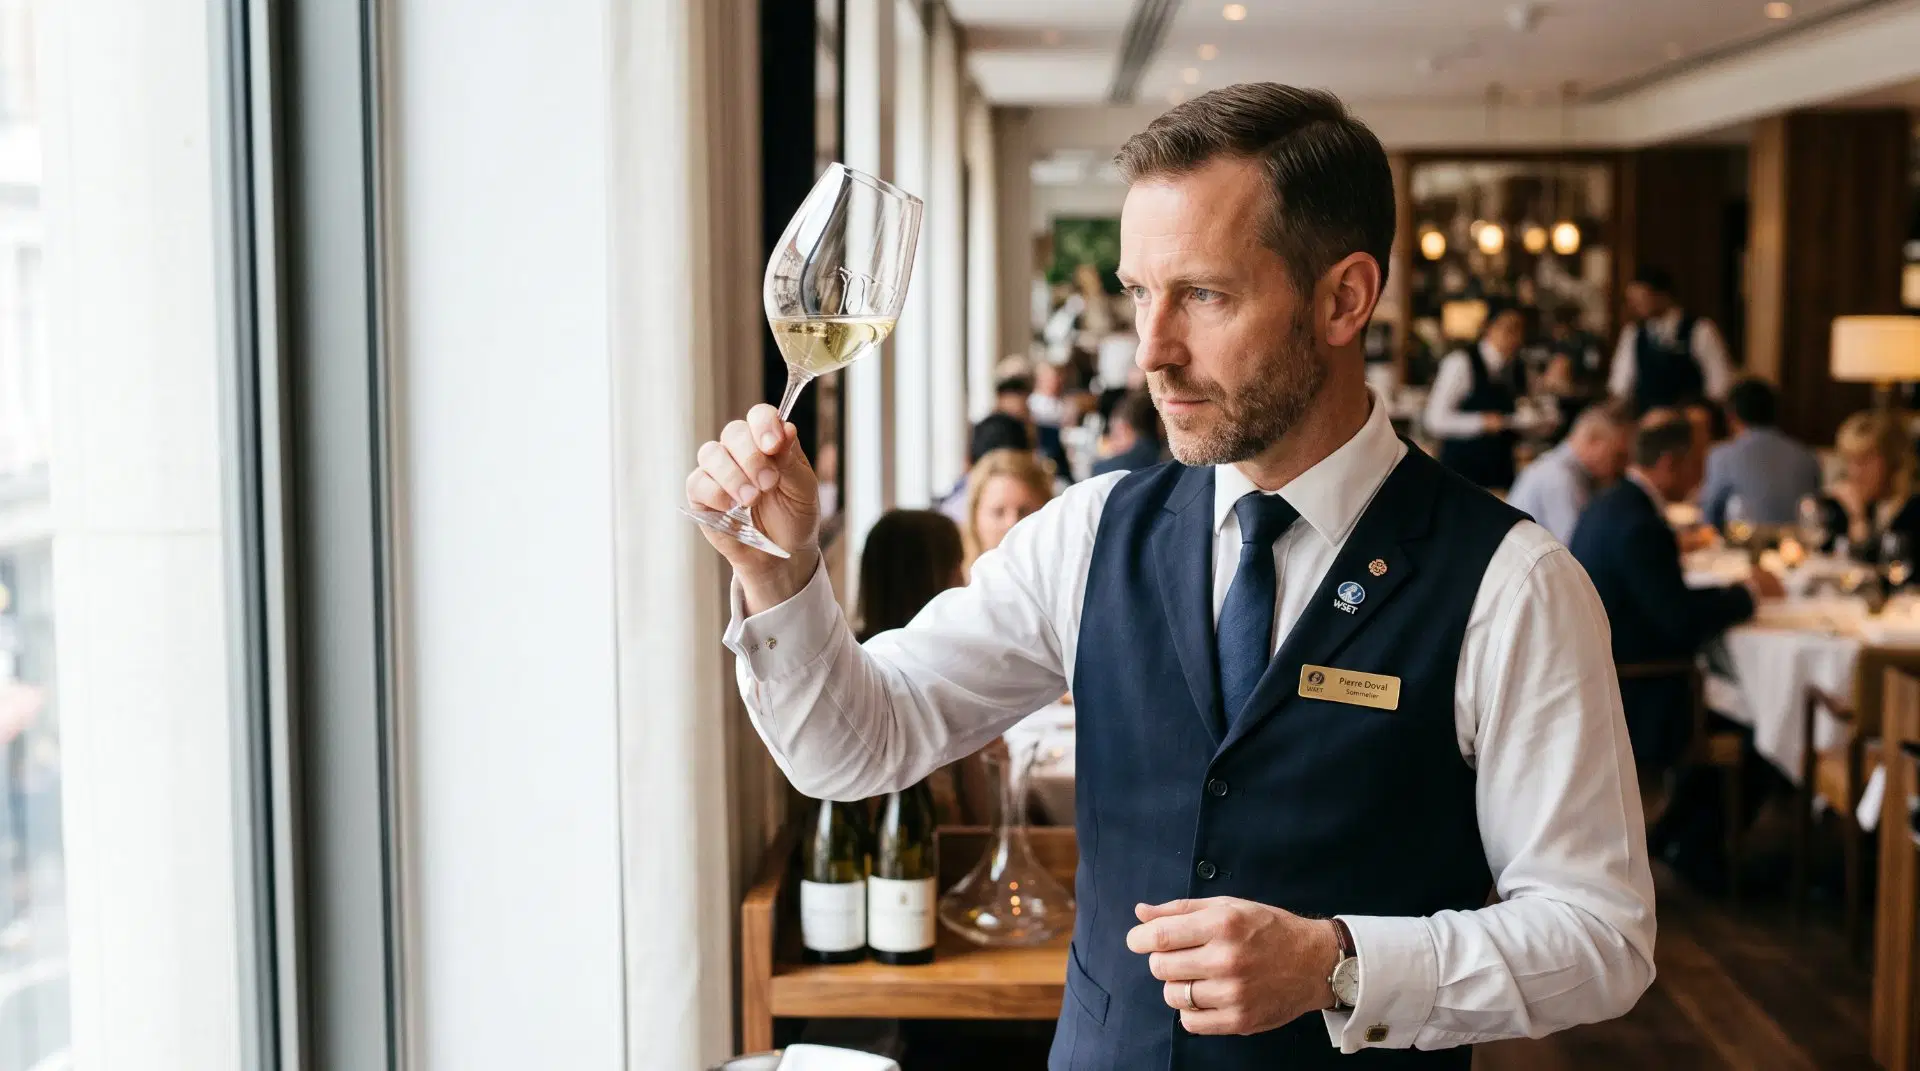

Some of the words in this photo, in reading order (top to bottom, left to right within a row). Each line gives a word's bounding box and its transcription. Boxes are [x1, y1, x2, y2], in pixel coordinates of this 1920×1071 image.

[1333, 598, 1358, 615] WSET
[1339, 677, 1363, 688] Pierre
[1364, 680, 1388, 691] Doval
